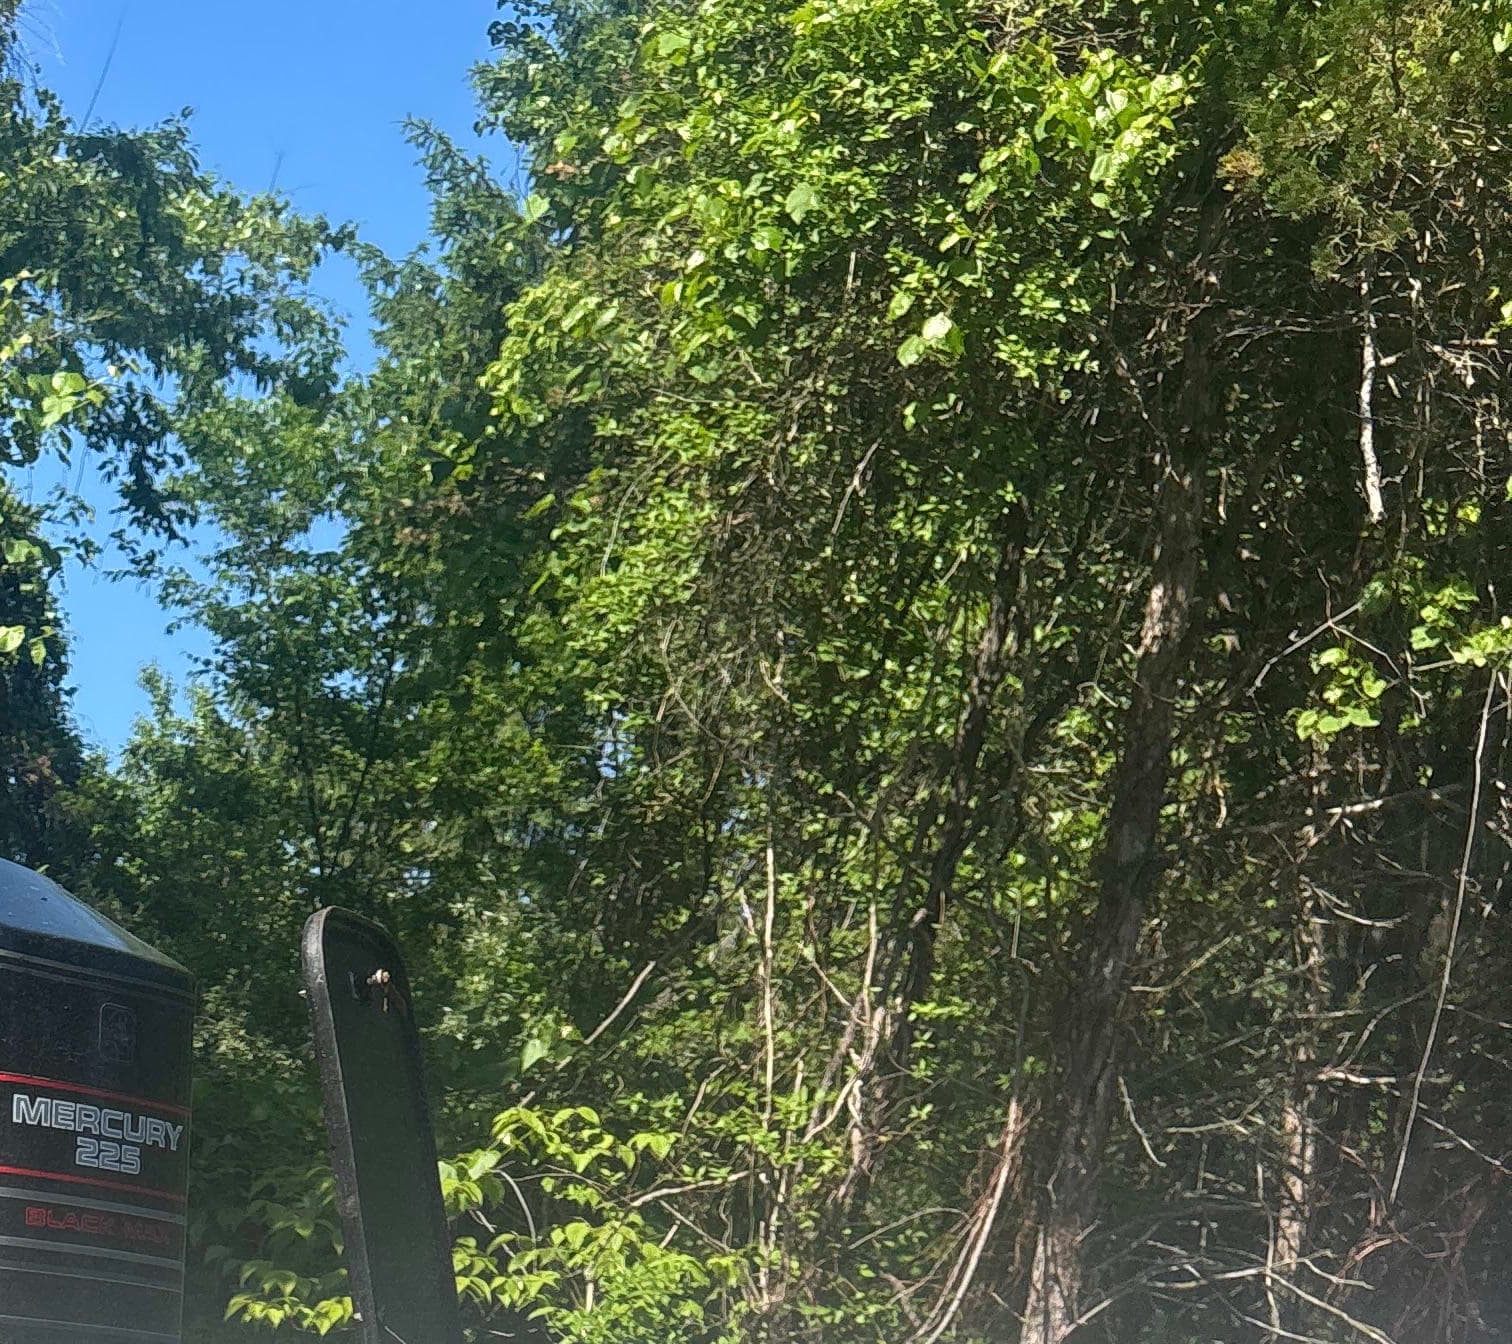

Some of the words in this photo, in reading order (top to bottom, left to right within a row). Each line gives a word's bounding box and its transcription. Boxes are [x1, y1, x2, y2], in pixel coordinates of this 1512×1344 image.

[12, 1093, 184, 1151] MERCURY
[75, 1136, 141, 1175] 225
[25, 1206, 115, 1235] BLACK
